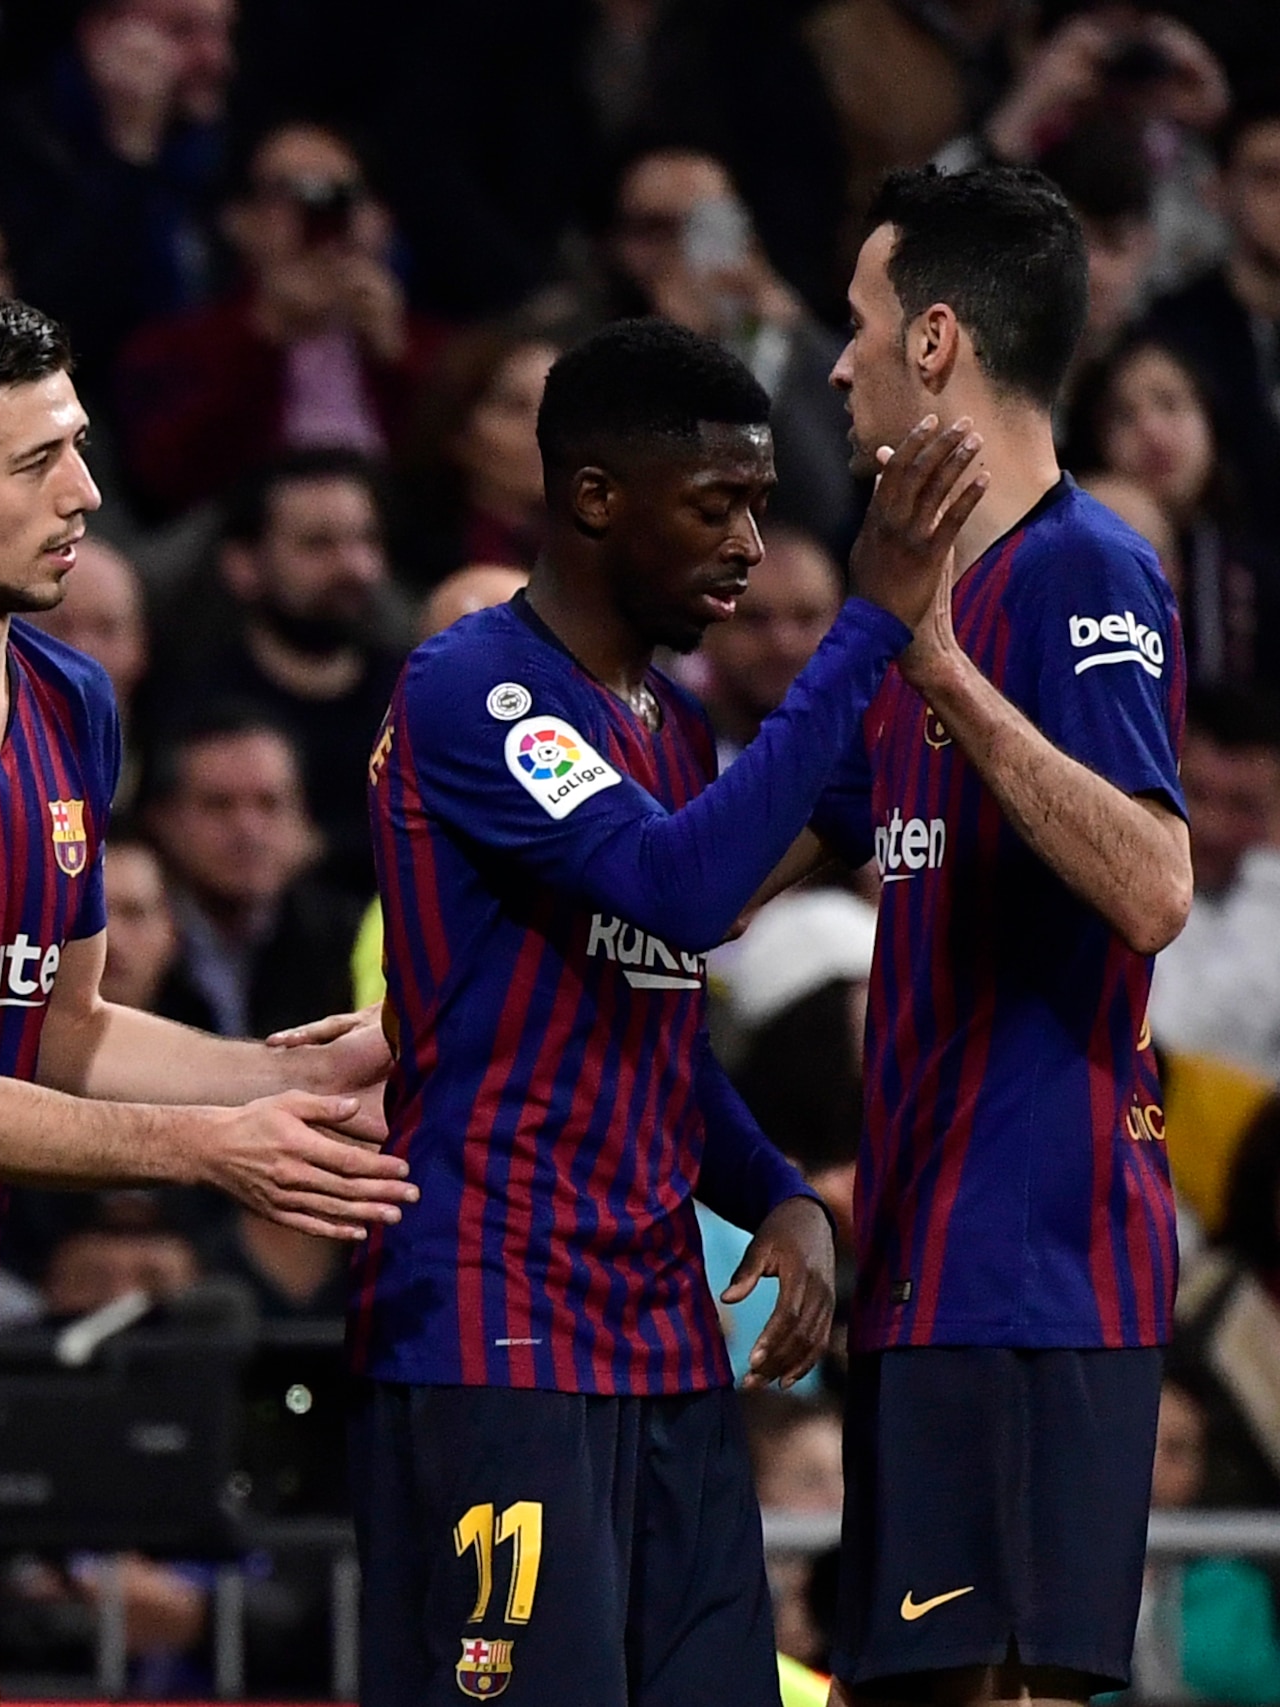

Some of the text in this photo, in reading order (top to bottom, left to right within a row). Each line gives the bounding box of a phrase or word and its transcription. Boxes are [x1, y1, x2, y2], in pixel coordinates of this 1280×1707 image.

[1069, 611, 1164, 664] beko
[548, 766, 606, 804] LaLiga
[453, 1500, 543, 1625] 11
